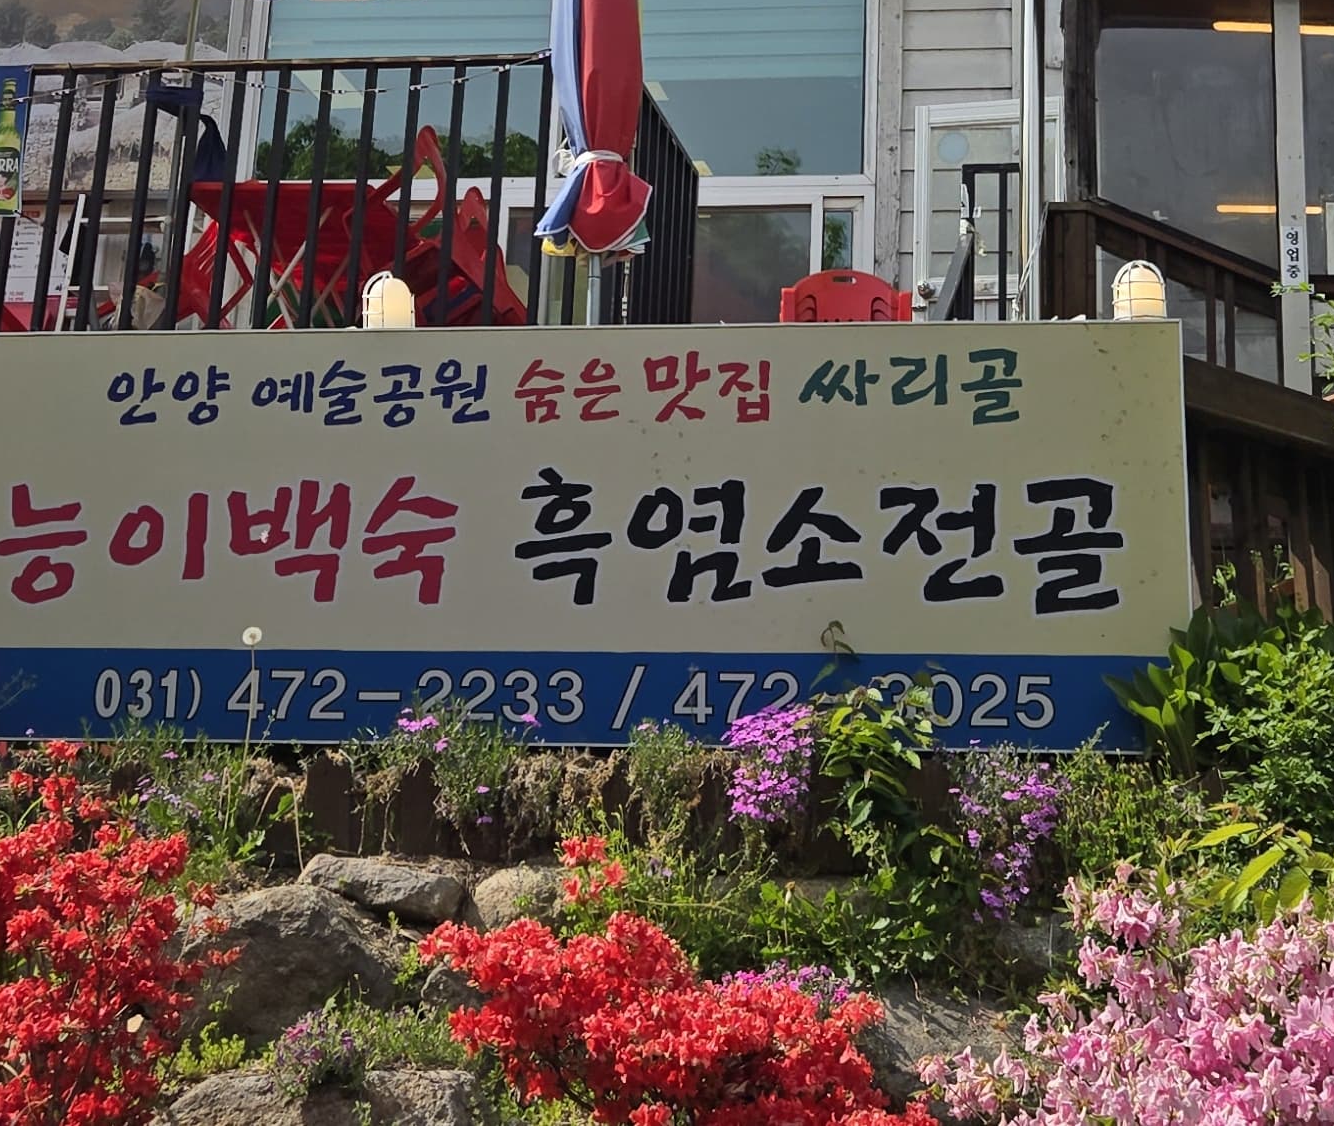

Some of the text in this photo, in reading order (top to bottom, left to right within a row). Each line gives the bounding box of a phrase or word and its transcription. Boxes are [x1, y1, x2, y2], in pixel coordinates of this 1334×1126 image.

[107, 347, 1024, 428] 안양 예술공원 숨은 맛집 싸리골
[513, 467, 1125, 616] 흑염소전골
[94, 669, 203, 722] 031)
[226, 668, 587, 726] 472-2233
